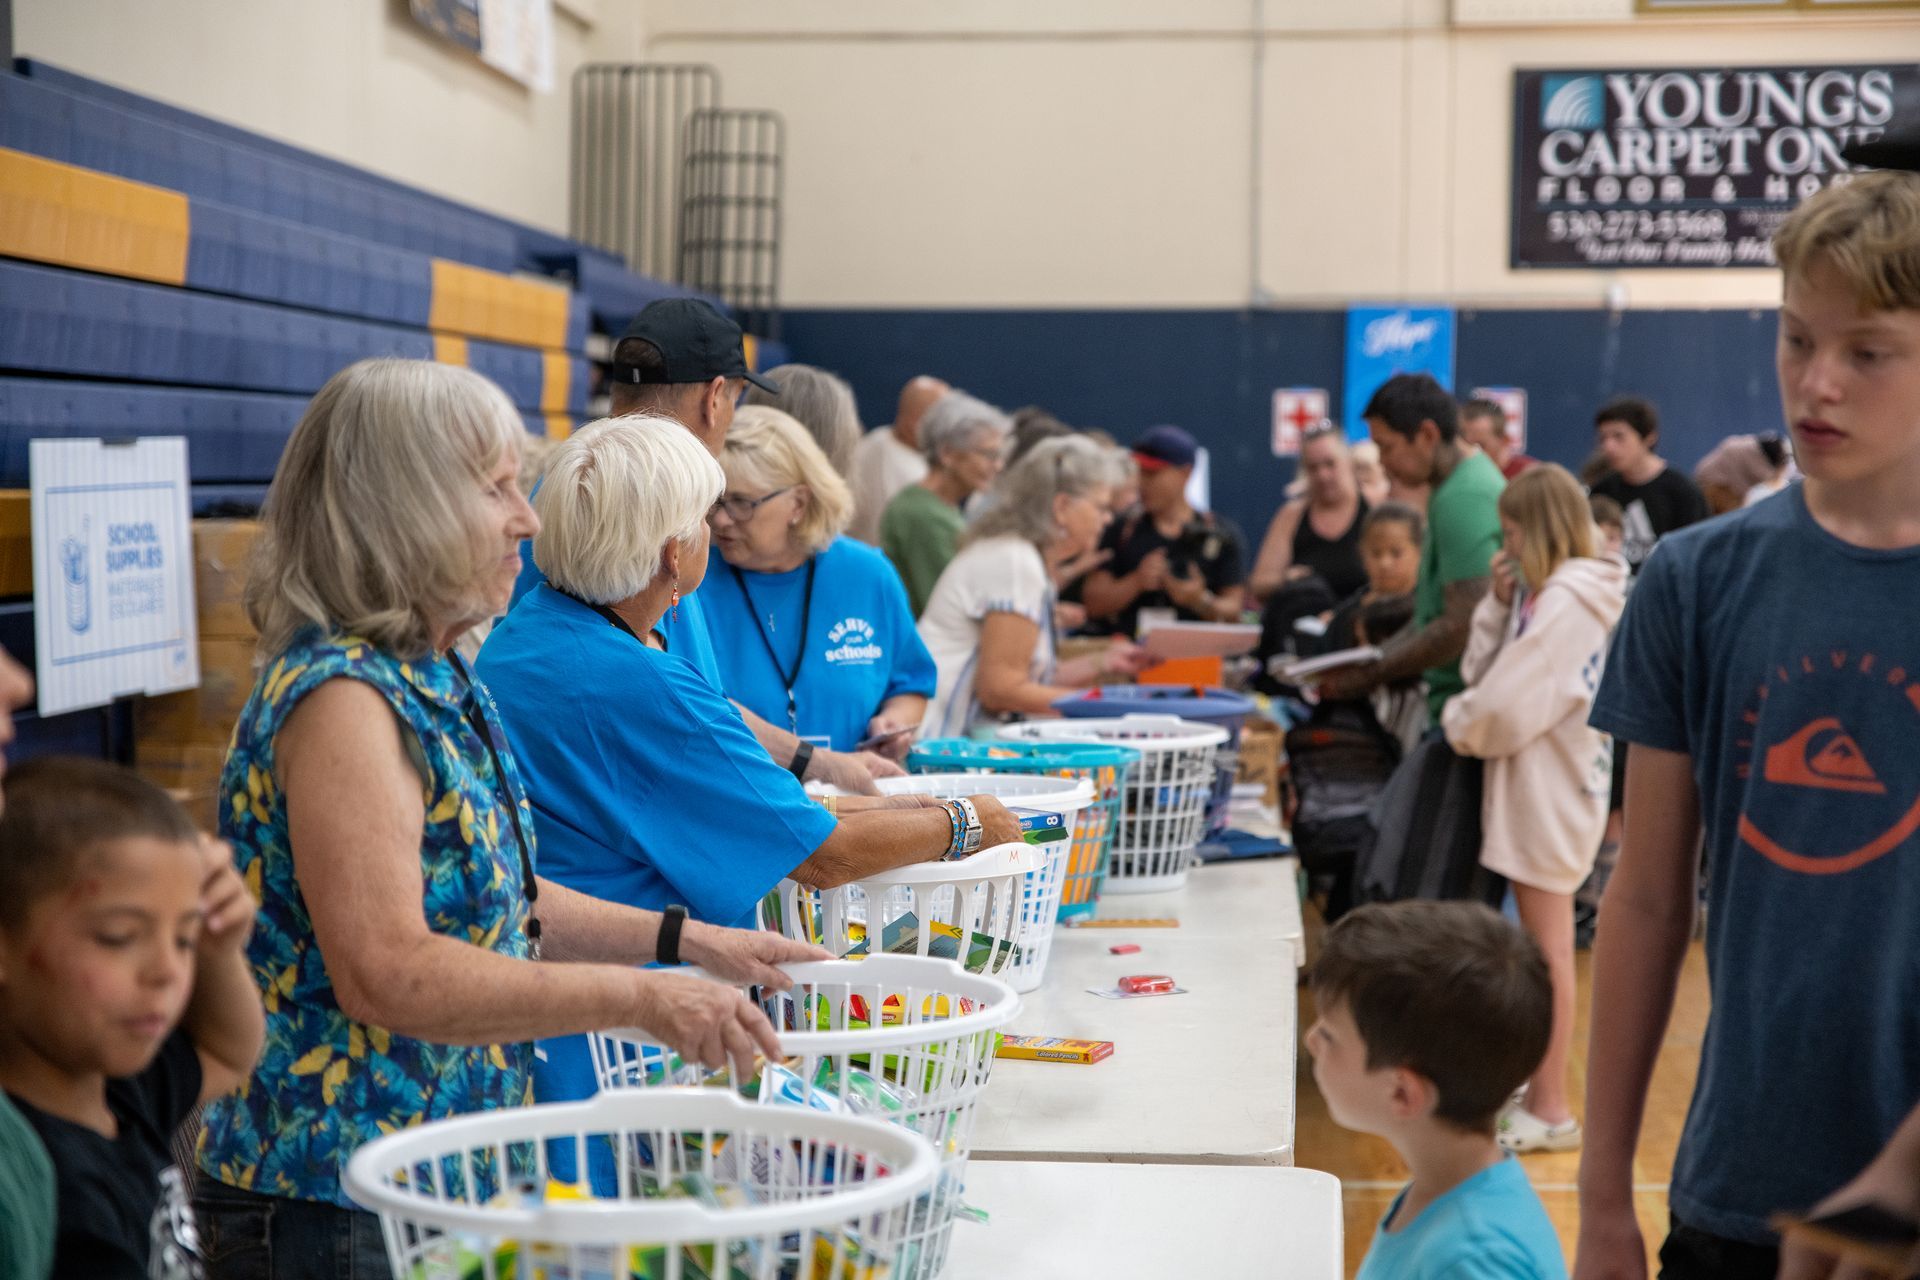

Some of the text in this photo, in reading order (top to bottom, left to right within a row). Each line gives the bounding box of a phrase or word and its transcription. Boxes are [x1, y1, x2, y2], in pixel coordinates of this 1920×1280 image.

[1606, 69, 1894, 128] YOUNGS
[1538, 127, 1760, 176] CARPET
[1538, 176, 1686, 204] FLOOR
[1712, 175, 1737, 203] &
[106, 521, 159, 547] SCHOOL
[106, 547, 163, 574] SUPPLIES
[825, 643, 882, 662] schools
[1036, 1051, 1059, 1059] Colored
